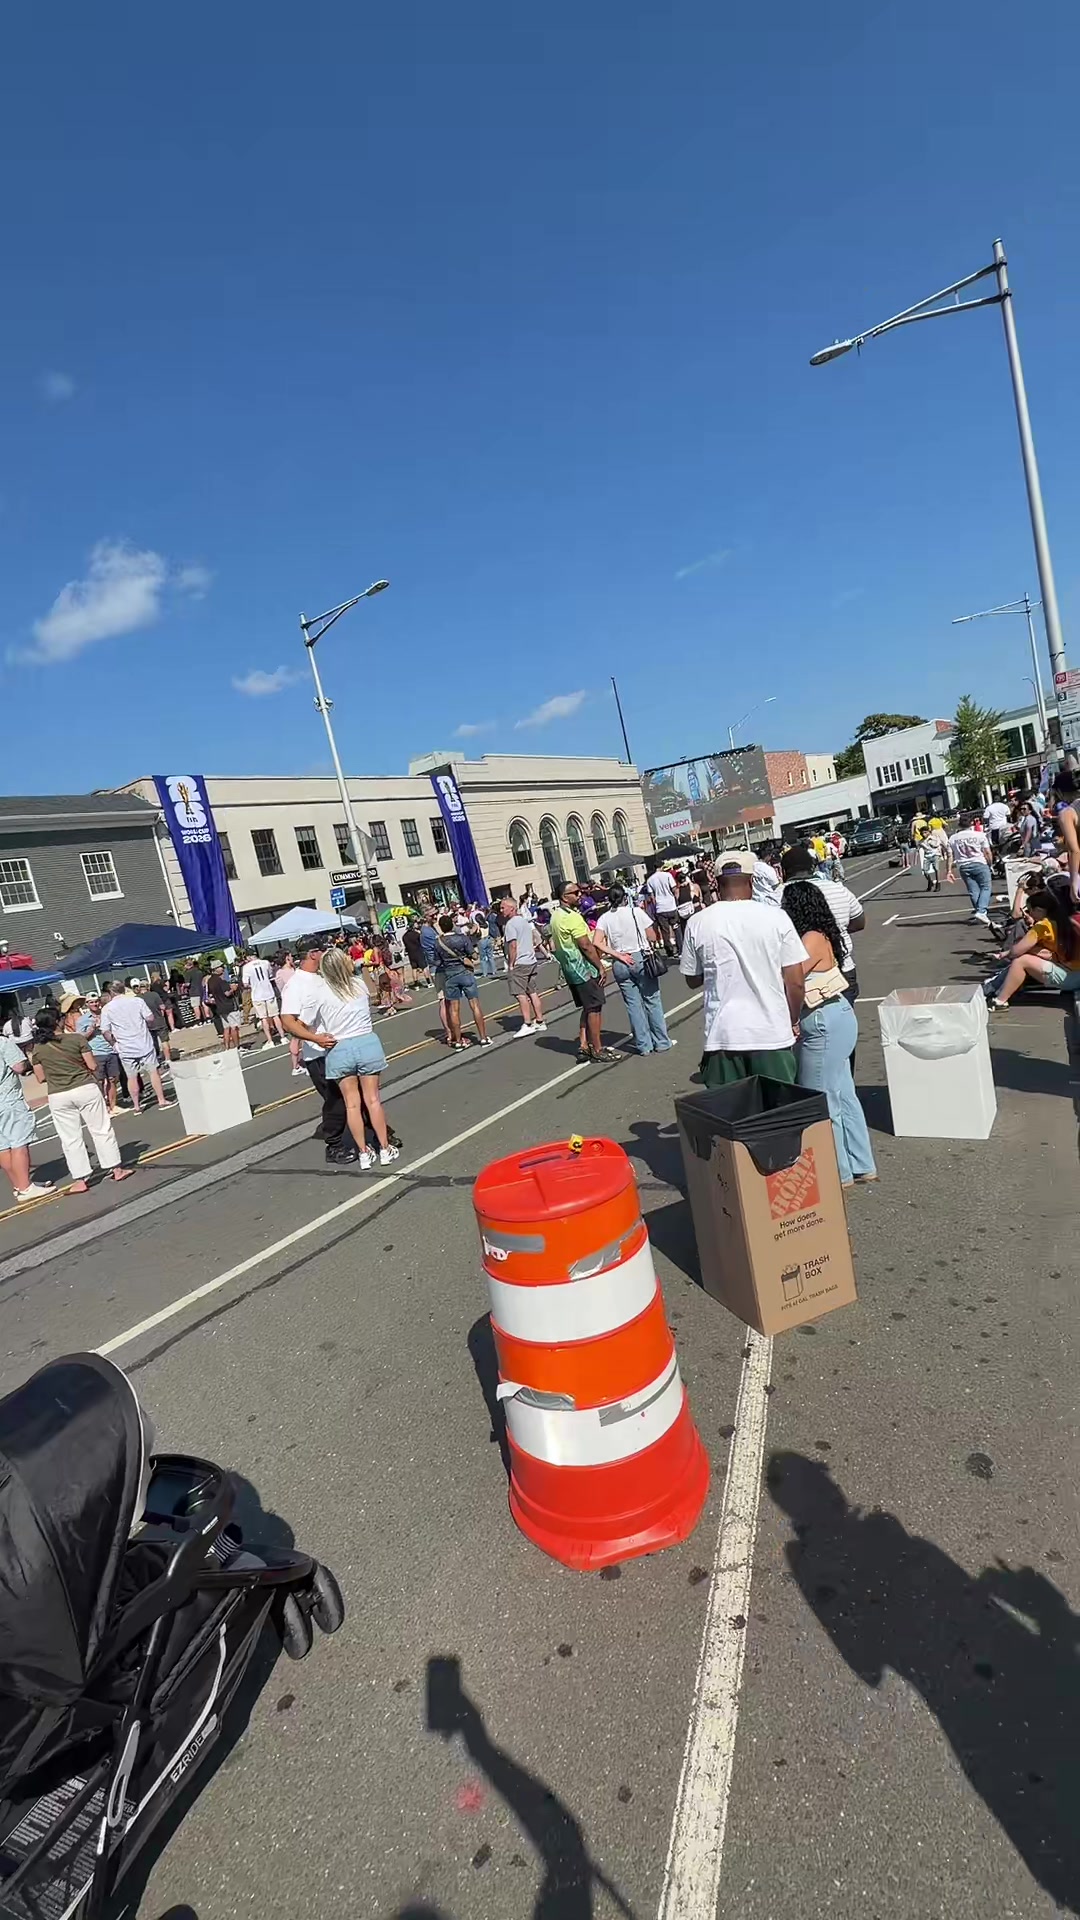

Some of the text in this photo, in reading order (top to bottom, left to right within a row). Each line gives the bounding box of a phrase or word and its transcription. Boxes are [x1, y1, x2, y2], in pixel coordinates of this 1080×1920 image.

[658, 818, 690, 831] verizon
[182, 833, 212, 844] 2026
[333, 872, 357, 882] COMMON
[254, 966, 265, 982] 11
[770, 1148, 815, 1217] HOME
[789, 1171, 817, 1211] DEPOT
[779, 1210, 817, 1229] How doers
[774, 1216, 826, 1241] get more done.
[803, 1254, 830, 1271] TRASH
[805, 1266, 823, 1280] BOX
[809, 1289, 825, 1300] TRASH
[825, 1284, 839, 1294] BAGS
[170, 1734, 205, 1784] EZRIDE
